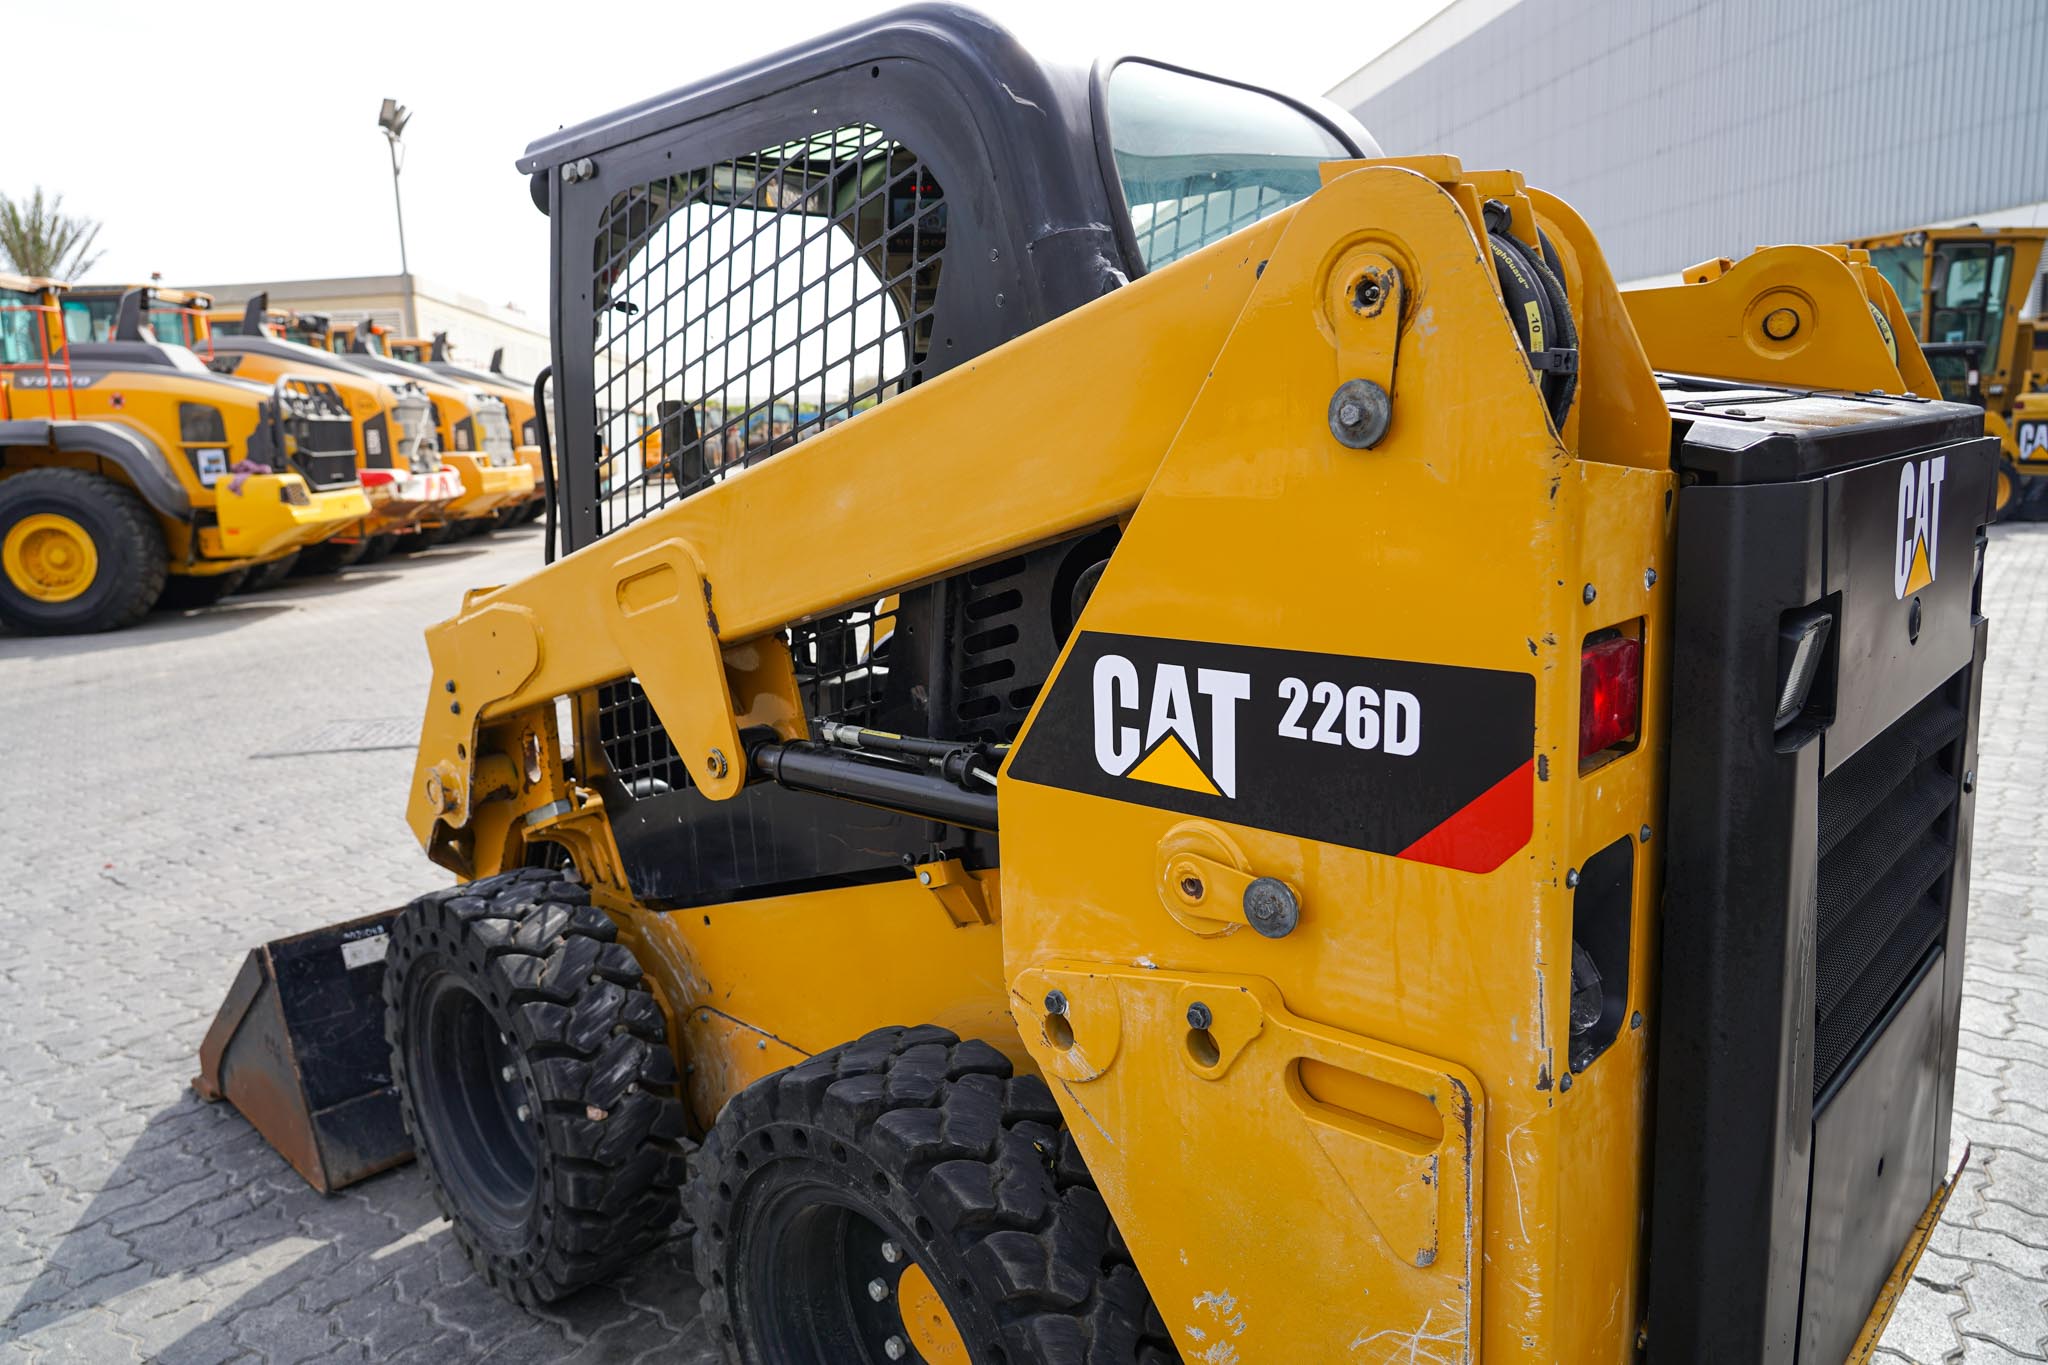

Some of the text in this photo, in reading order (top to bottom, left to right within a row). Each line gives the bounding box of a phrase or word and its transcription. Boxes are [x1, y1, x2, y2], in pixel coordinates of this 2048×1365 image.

[21, 375, 92, 387] VOLVO
[2019, 423, 2048, 460] CA
[1894, 456, 1946, 601] CAT
[1093, 654, 1421, 799] CAT 226D
